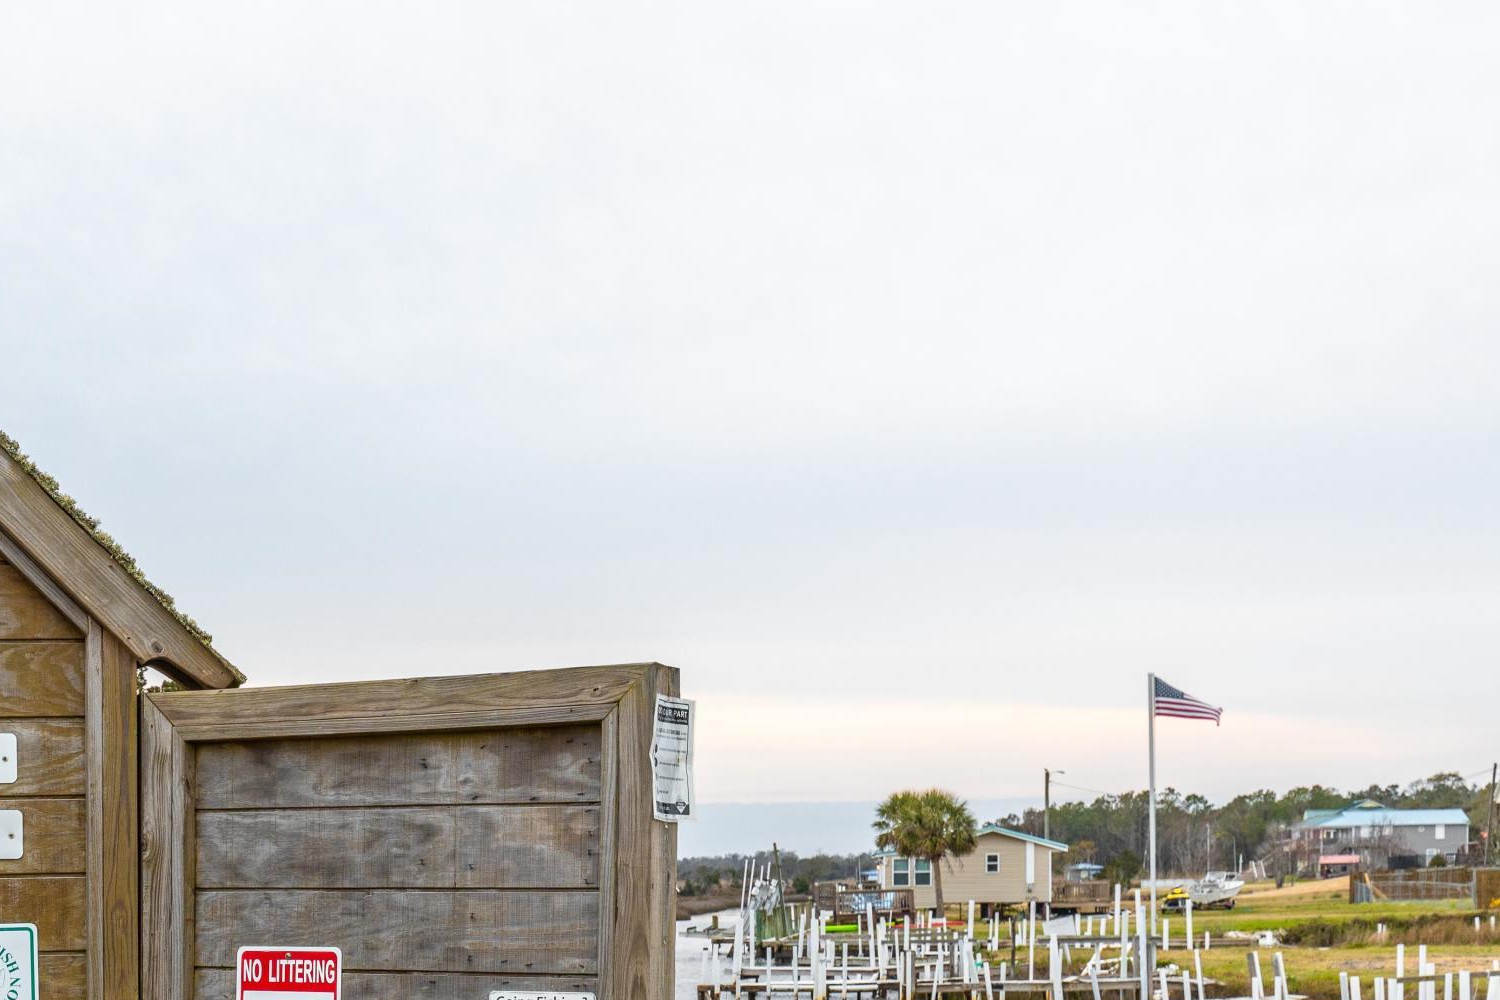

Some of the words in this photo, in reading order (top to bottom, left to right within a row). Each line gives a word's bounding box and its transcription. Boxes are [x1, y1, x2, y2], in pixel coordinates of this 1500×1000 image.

[674, 709, 688, 718] PART
[243, 959, 262, 983] NO
[269, 959, 335, 984] LITTERING
